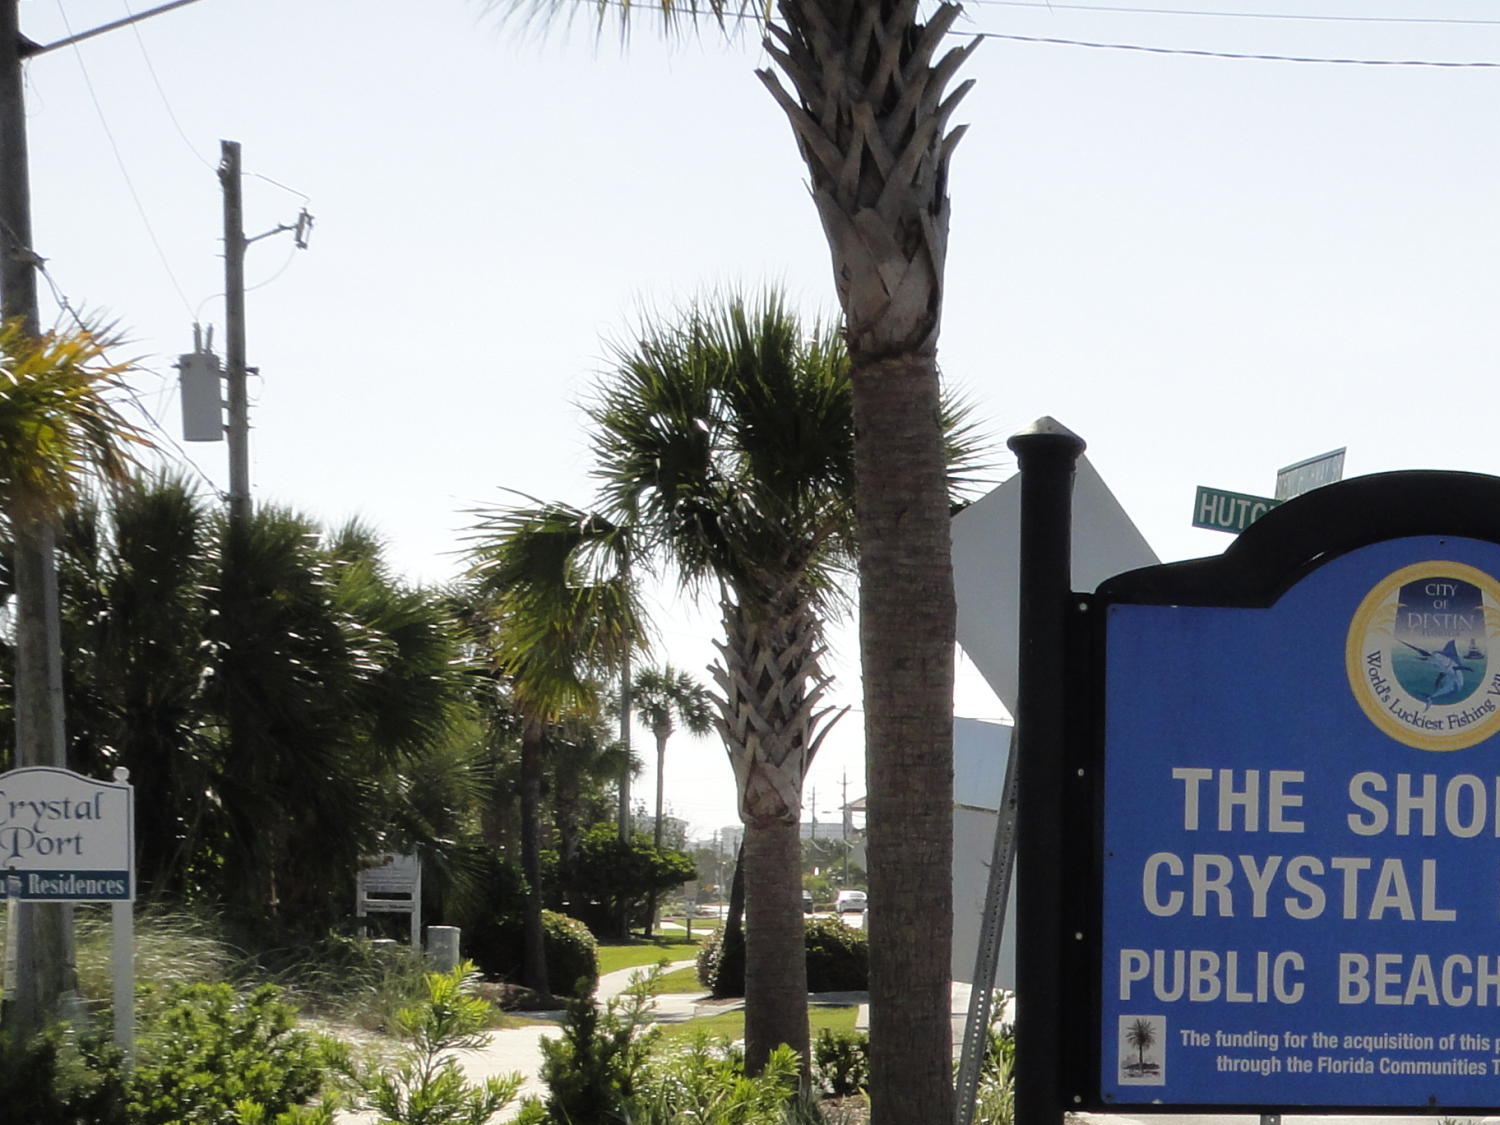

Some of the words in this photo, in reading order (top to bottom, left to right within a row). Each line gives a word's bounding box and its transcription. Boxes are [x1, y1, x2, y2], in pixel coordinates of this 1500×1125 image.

[1200, 492, 1277, 529] HUTC
[1425, 583, 1458, 597] CITY
[1433, 600, 1449, 610] OF
[1407, 612, 1475, 630] DESTIN
[1366, 650, 1392, 703] World's
[1389, 698, 1444, 730] Luckiest
[1447, 699, 1497, 730] Fishing
[1171, 767, 1306, 833] THE
[0, 826, 83, 859] Port
[28, 873, 125, 895] Residences
[1142, 852, 1457, 922] CRYSTAL
[1118, 948, 1305, 1004] PUBLIC
[1180, 1029, 1210, 1047] The
[1216, 1030, 1279, 1051] funding
[1284, 1031, 1308, 1048] for
[1312, 1032, 1338, 1049] the
[1343, 1032, 1434, 1052] acquisition
[1438, 1033, 1456, 1050] of
[1459, 1034, 1490, 1051] this
[1216, 1055, 1281, 1076] through
[1286, 1056, 1313, 1073] the
[1317, 1056, 1374, 1074] Florida
[1379, 1057, 1487, 1076] Communities
